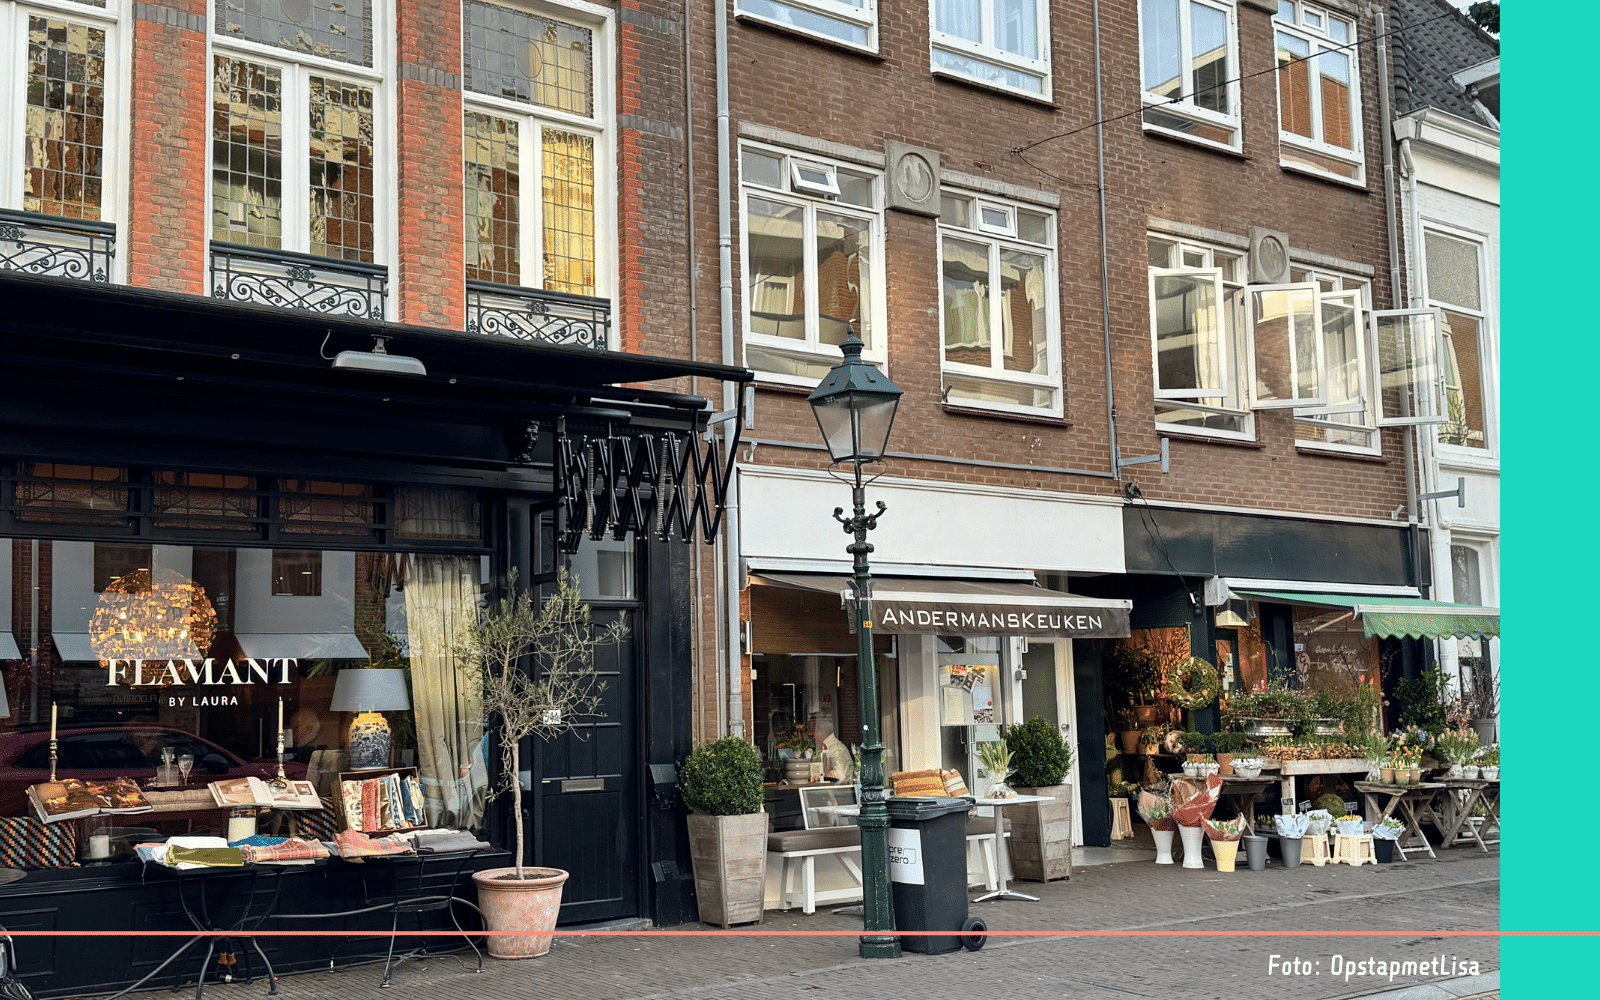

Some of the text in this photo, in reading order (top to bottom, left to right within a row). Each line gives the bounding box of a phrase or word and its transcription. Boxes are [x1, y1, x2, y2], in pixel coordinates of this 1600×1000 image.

[105, 657, 298, 686] FLAMANT
[168, 696, 239, 707] BY LAURA
[889, 855, 909, 864] zero
